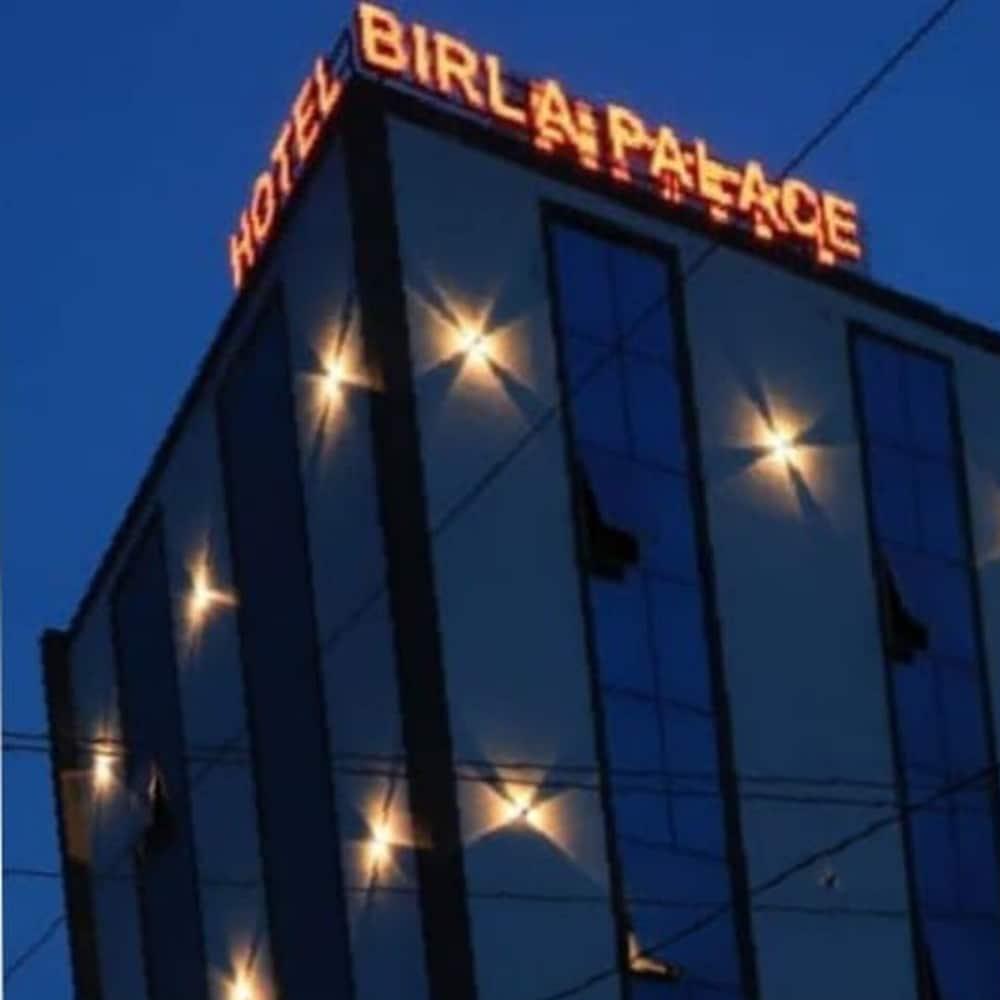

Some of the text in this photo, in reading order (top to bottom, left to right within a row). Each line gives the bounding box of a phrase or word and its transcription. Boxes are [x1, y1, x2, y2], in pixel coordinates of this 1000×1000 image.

[229, 56, 343, 289] HOTEL
[355, 1, 862, 262] BIRLA PALACE
